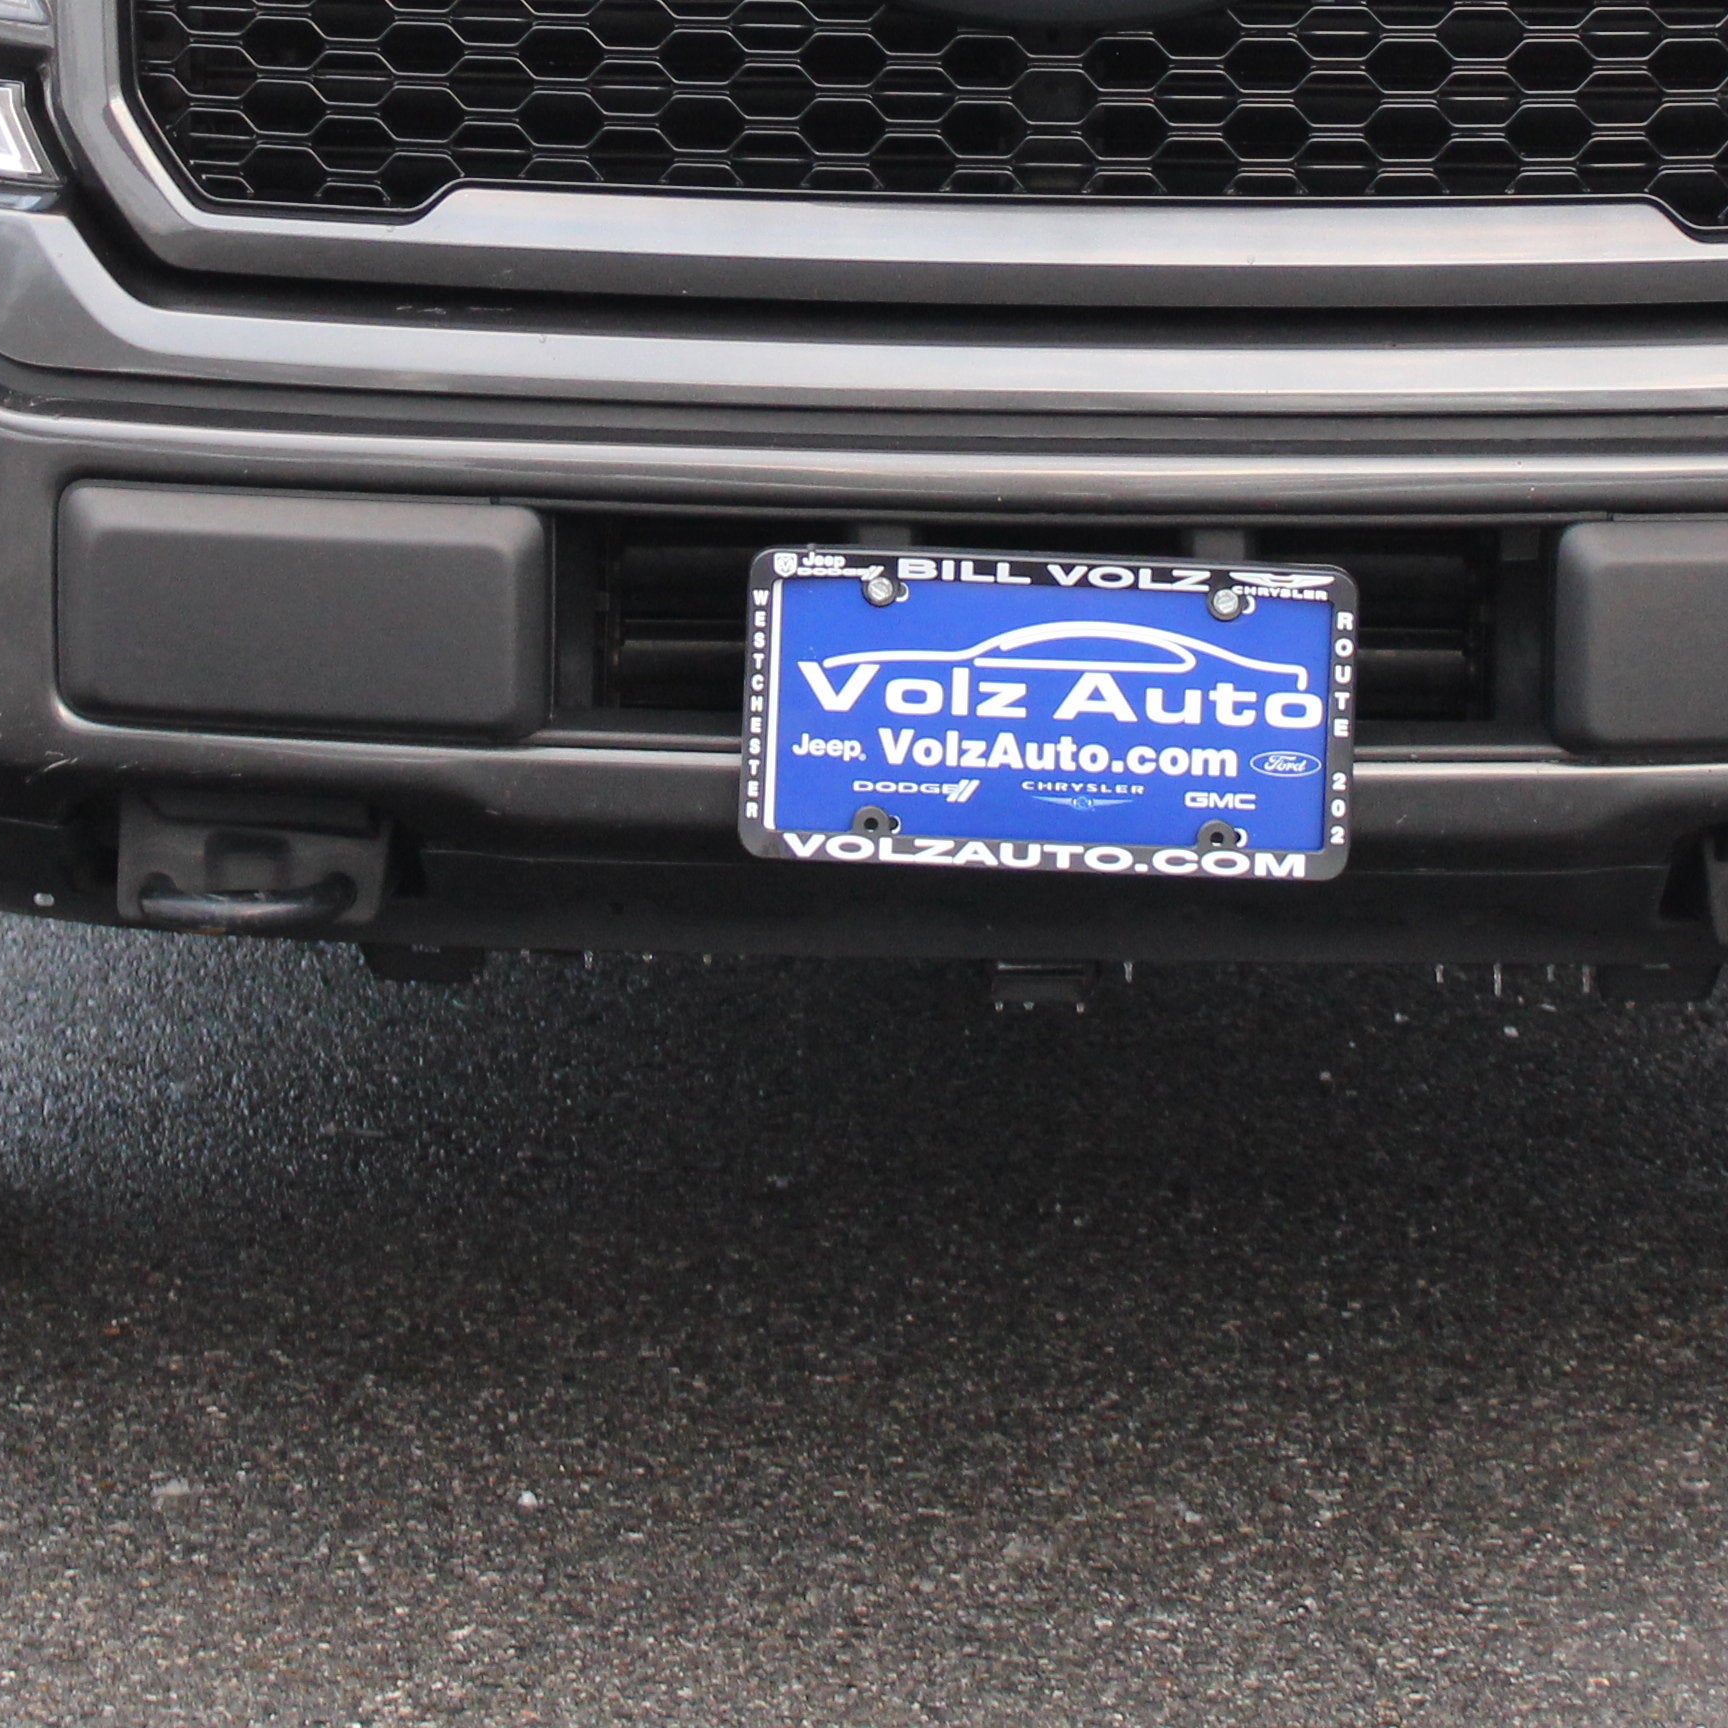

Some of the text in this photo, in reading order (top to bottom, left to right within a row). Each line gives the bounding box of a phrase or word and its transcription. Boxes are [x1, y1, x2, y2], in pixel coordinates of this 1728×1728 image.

[802, 551, 847, 569] Jeep
[897, 557, 1212, 593] BILL VOLZ
[1231, 585, 1329, 602] CHRYSLER
[1332, 610, 1355, 740] ROUTE
[745, 589, 770, 820] WESTCHESTER
[797, 660, 1324, 730] Volz Auto
[877, 727, 1239, 778] VolzAuto.com
[1261, 754, 1308, 773] Ford
[852, 779, 970, 797] DODGE
[1021, 779, 1146, 795] CHRYSLER
[1183, 790, 1258, 811] GMC
[1329, 771, 1348, 846] 202
[782, 831, 1307, 880] VOLZAUTO.COM
